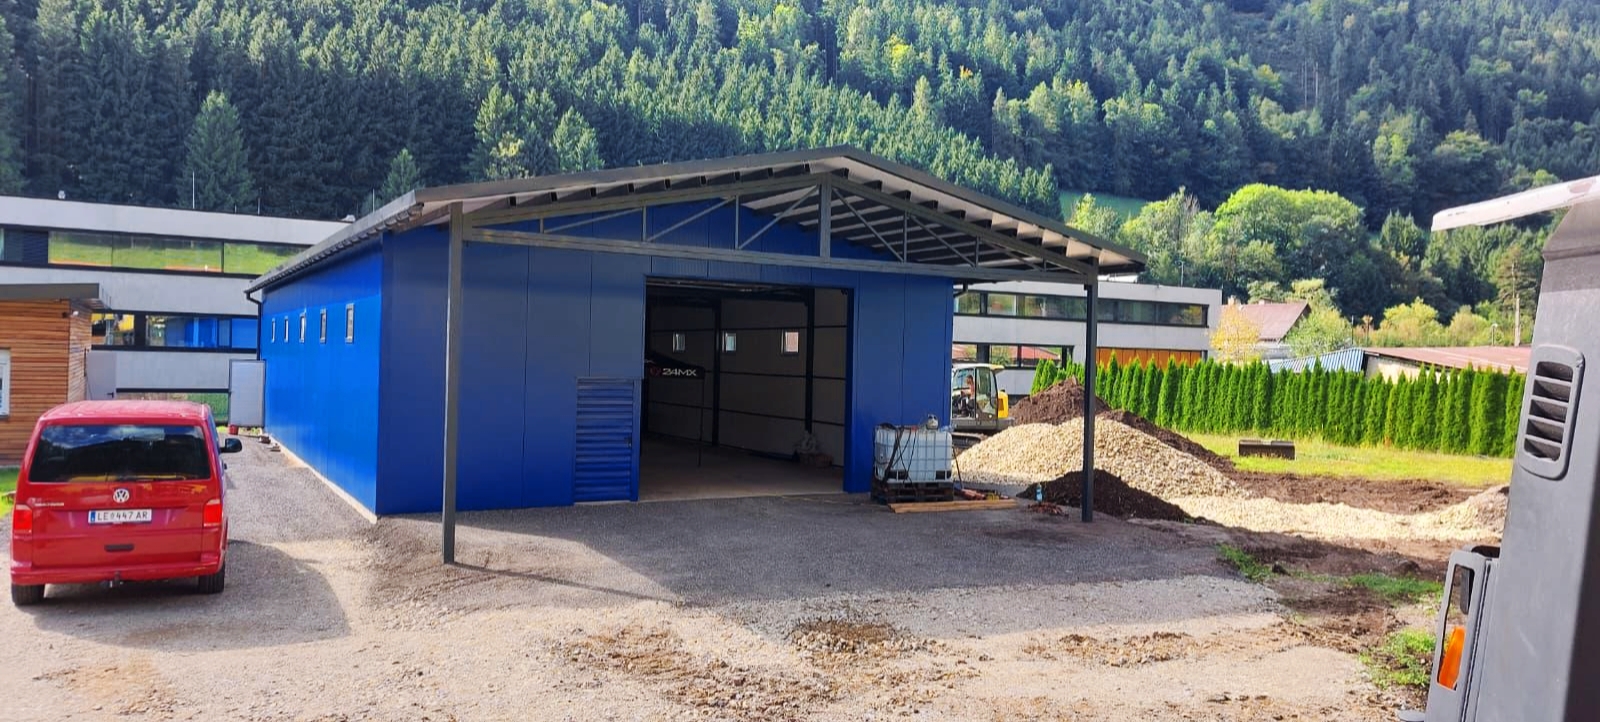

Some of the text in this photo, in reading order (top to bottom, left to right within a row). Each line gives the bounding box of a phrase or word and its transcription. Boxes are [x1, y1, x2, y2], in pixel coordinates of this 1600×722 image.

[662, 368, 697, 376] 24MX
[97, 511, 148, 521] LE 447 AR
